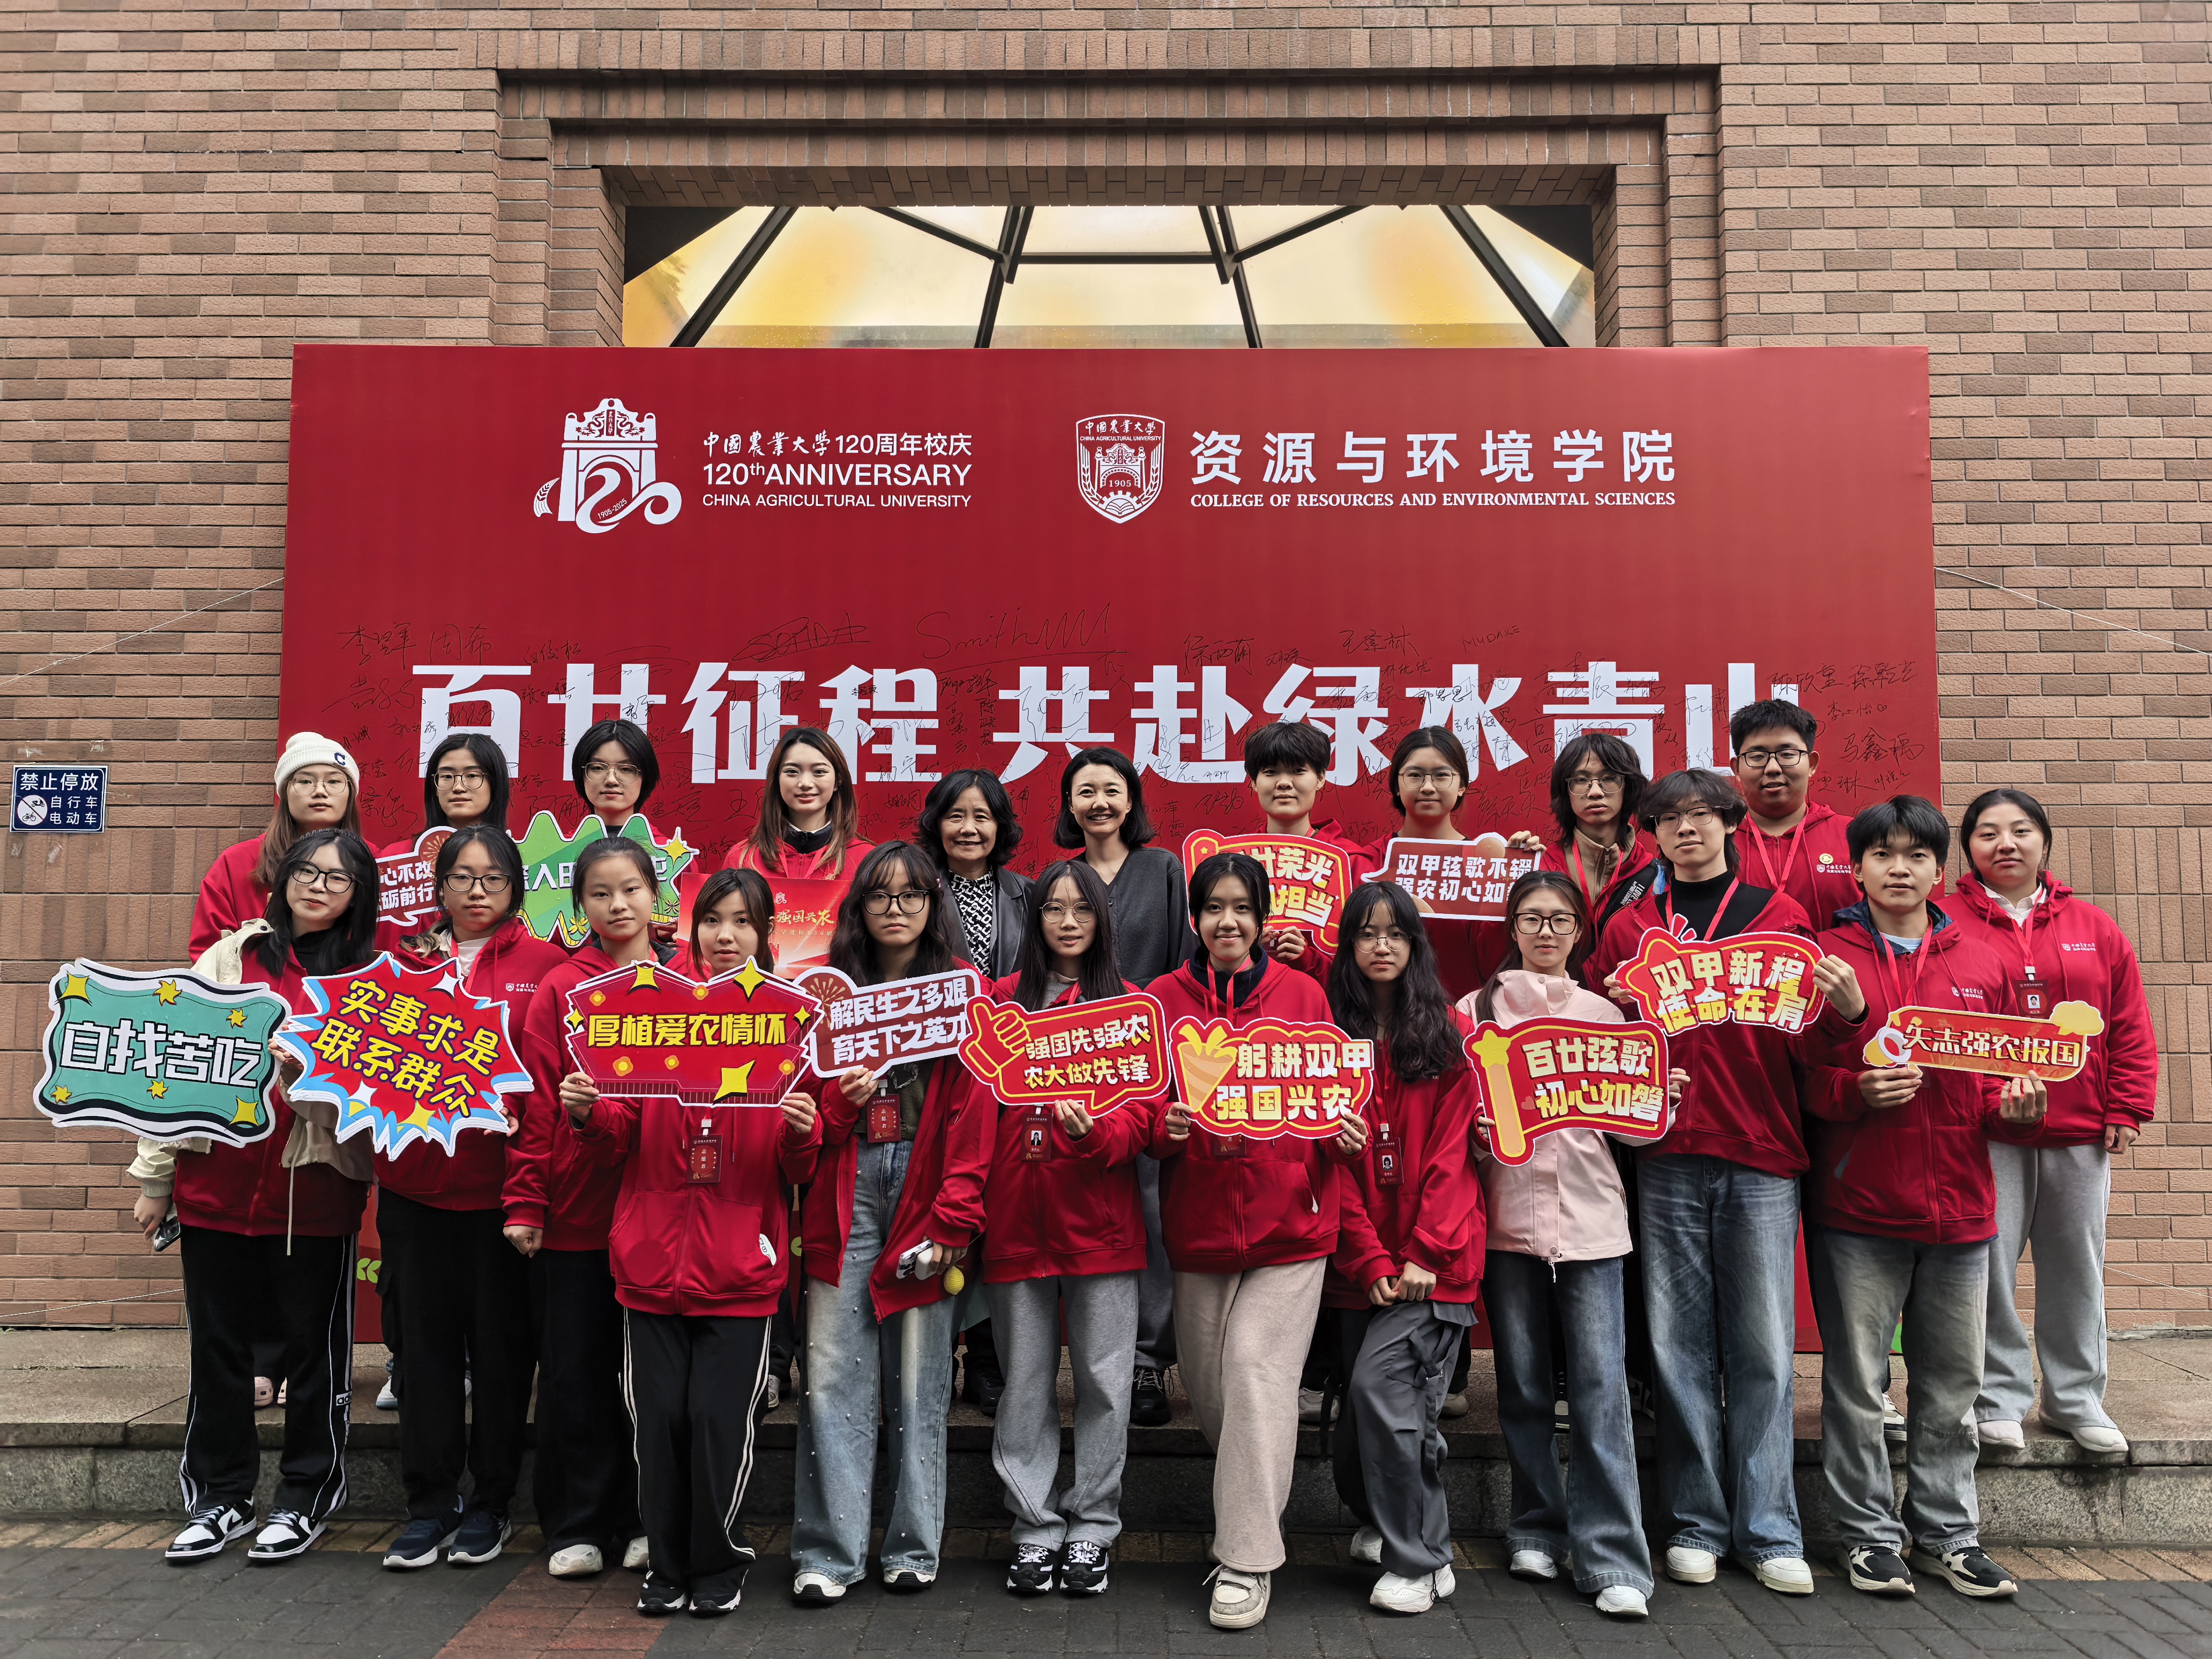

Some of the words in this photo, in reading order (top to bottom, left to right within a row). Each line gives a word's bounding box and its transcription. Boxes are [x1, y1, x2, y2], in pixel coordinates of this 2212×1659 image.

[1085, 419, 1156, 435] 中國農業大學
[1190, 429, 1675, 485] 资源与环境学院
[703, 494, 750, 506] CHINA
[755, 494, 875, 507] AGRICULTURAL
[881, 495, 972, 507] UNIVERSITY
[1190, 494, 1264, 507] COLLEGE
[1270, 494, 1291, 507] OF
[1297, 493, 1394, 507] RESOURCES
[1399, 493, 1437, 506] AND
[1442, 493, 1589, 506] ENVIRONMENTAL
[1595, 492, 1675, 505] SCIENCES
[412, 662, 939, 786] 百廿征程
[993, 662, 1799, 786] 共赴绿水青山
[20, 772, 99, 791] 禁止停放
[51, 795, 98, 809] 自行车
[50, 811, 97, 825] 电动车
[1238, 846, 1334, 889] 廿荣光
[377, 882, 434, 911] 砺前行
[1269, 884, 1334, 928] 担当
[1395, 877, 1515, 903] 强农初心如
[1650, 949, 1806, 997] 双甲新程
[830, 977, 968, 1030] 解民生之多艰
[1656, 987, 1810, 1032] 使命在肩
[339, 980, 500, 1076] 实事求是
[587, 1013, 787, 1047] 厚植爱农情怀
[832, 1011, 970, 1065] 育天下之英才
[1024, 1014, 1151, 1061] 强国先强农
[60, 1019, 262, 1089] 自找苦吃
[310, 1017, 480, 1117] 联系群众
[1023, 1054, 1151, 1088] 农大做先锋
[1236, 1041, 1374, 1080] 躬耕双甲
[1521, 1036, 1653, 1078] 百廿弦歌
[1214, 1083, 1353, 1121] 强国兴农
[1534, 1078, 1664, 1124] 初心如磐
